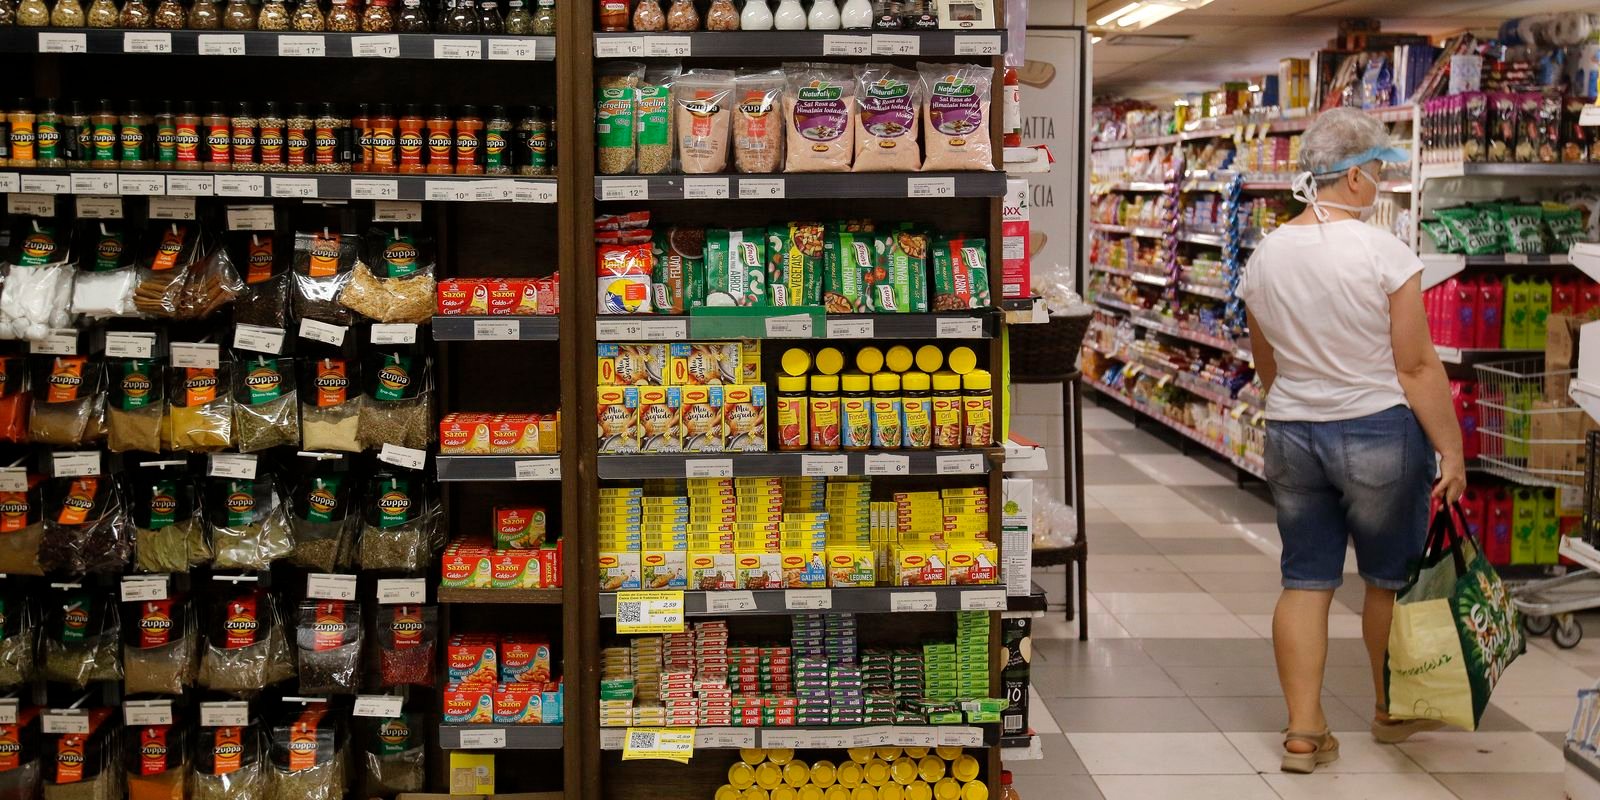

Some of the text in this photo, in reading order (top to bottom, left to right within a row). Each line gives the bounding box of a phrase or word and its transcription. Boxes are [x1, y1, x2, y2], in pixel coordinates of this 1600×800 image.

[1020, 116, 1054, 139] ATTA
[386, 248, 416, 261] zuppa
[791, 254, 802, 288] VEGETAIS
[50, 376, 80, 388] zuppa
[187, 378, 216, 390] zuppa
[248, 374, 280, 388] zuppa
[318, 377, 346, 390] zuppa
[380, 371, 408, 387] zuppa
[124, 380, 150, 392] zuppa
[66, 496, 92, 510] zuppa
[152, 500, 176, 510] zuppa
[228, 498, 254, 509] zuppa
[310, 494, 335, 509] zuppa
[380, 498, 408, 510] zuppa
[0, 504, 28, 514] zuppa
[971, 572, 990, 580] CARNE
[141, 619, 171, 630] zuppa
[226, 620, 256, 632] zuppa
[314, 622, 345, 634] zuppa
[392, 621, 423, 632] zuppa
[1006, 688, 1022, 702] 10
[216, 744, 241, 756] zuppa
[290, 741, 316, 752] zuppa
